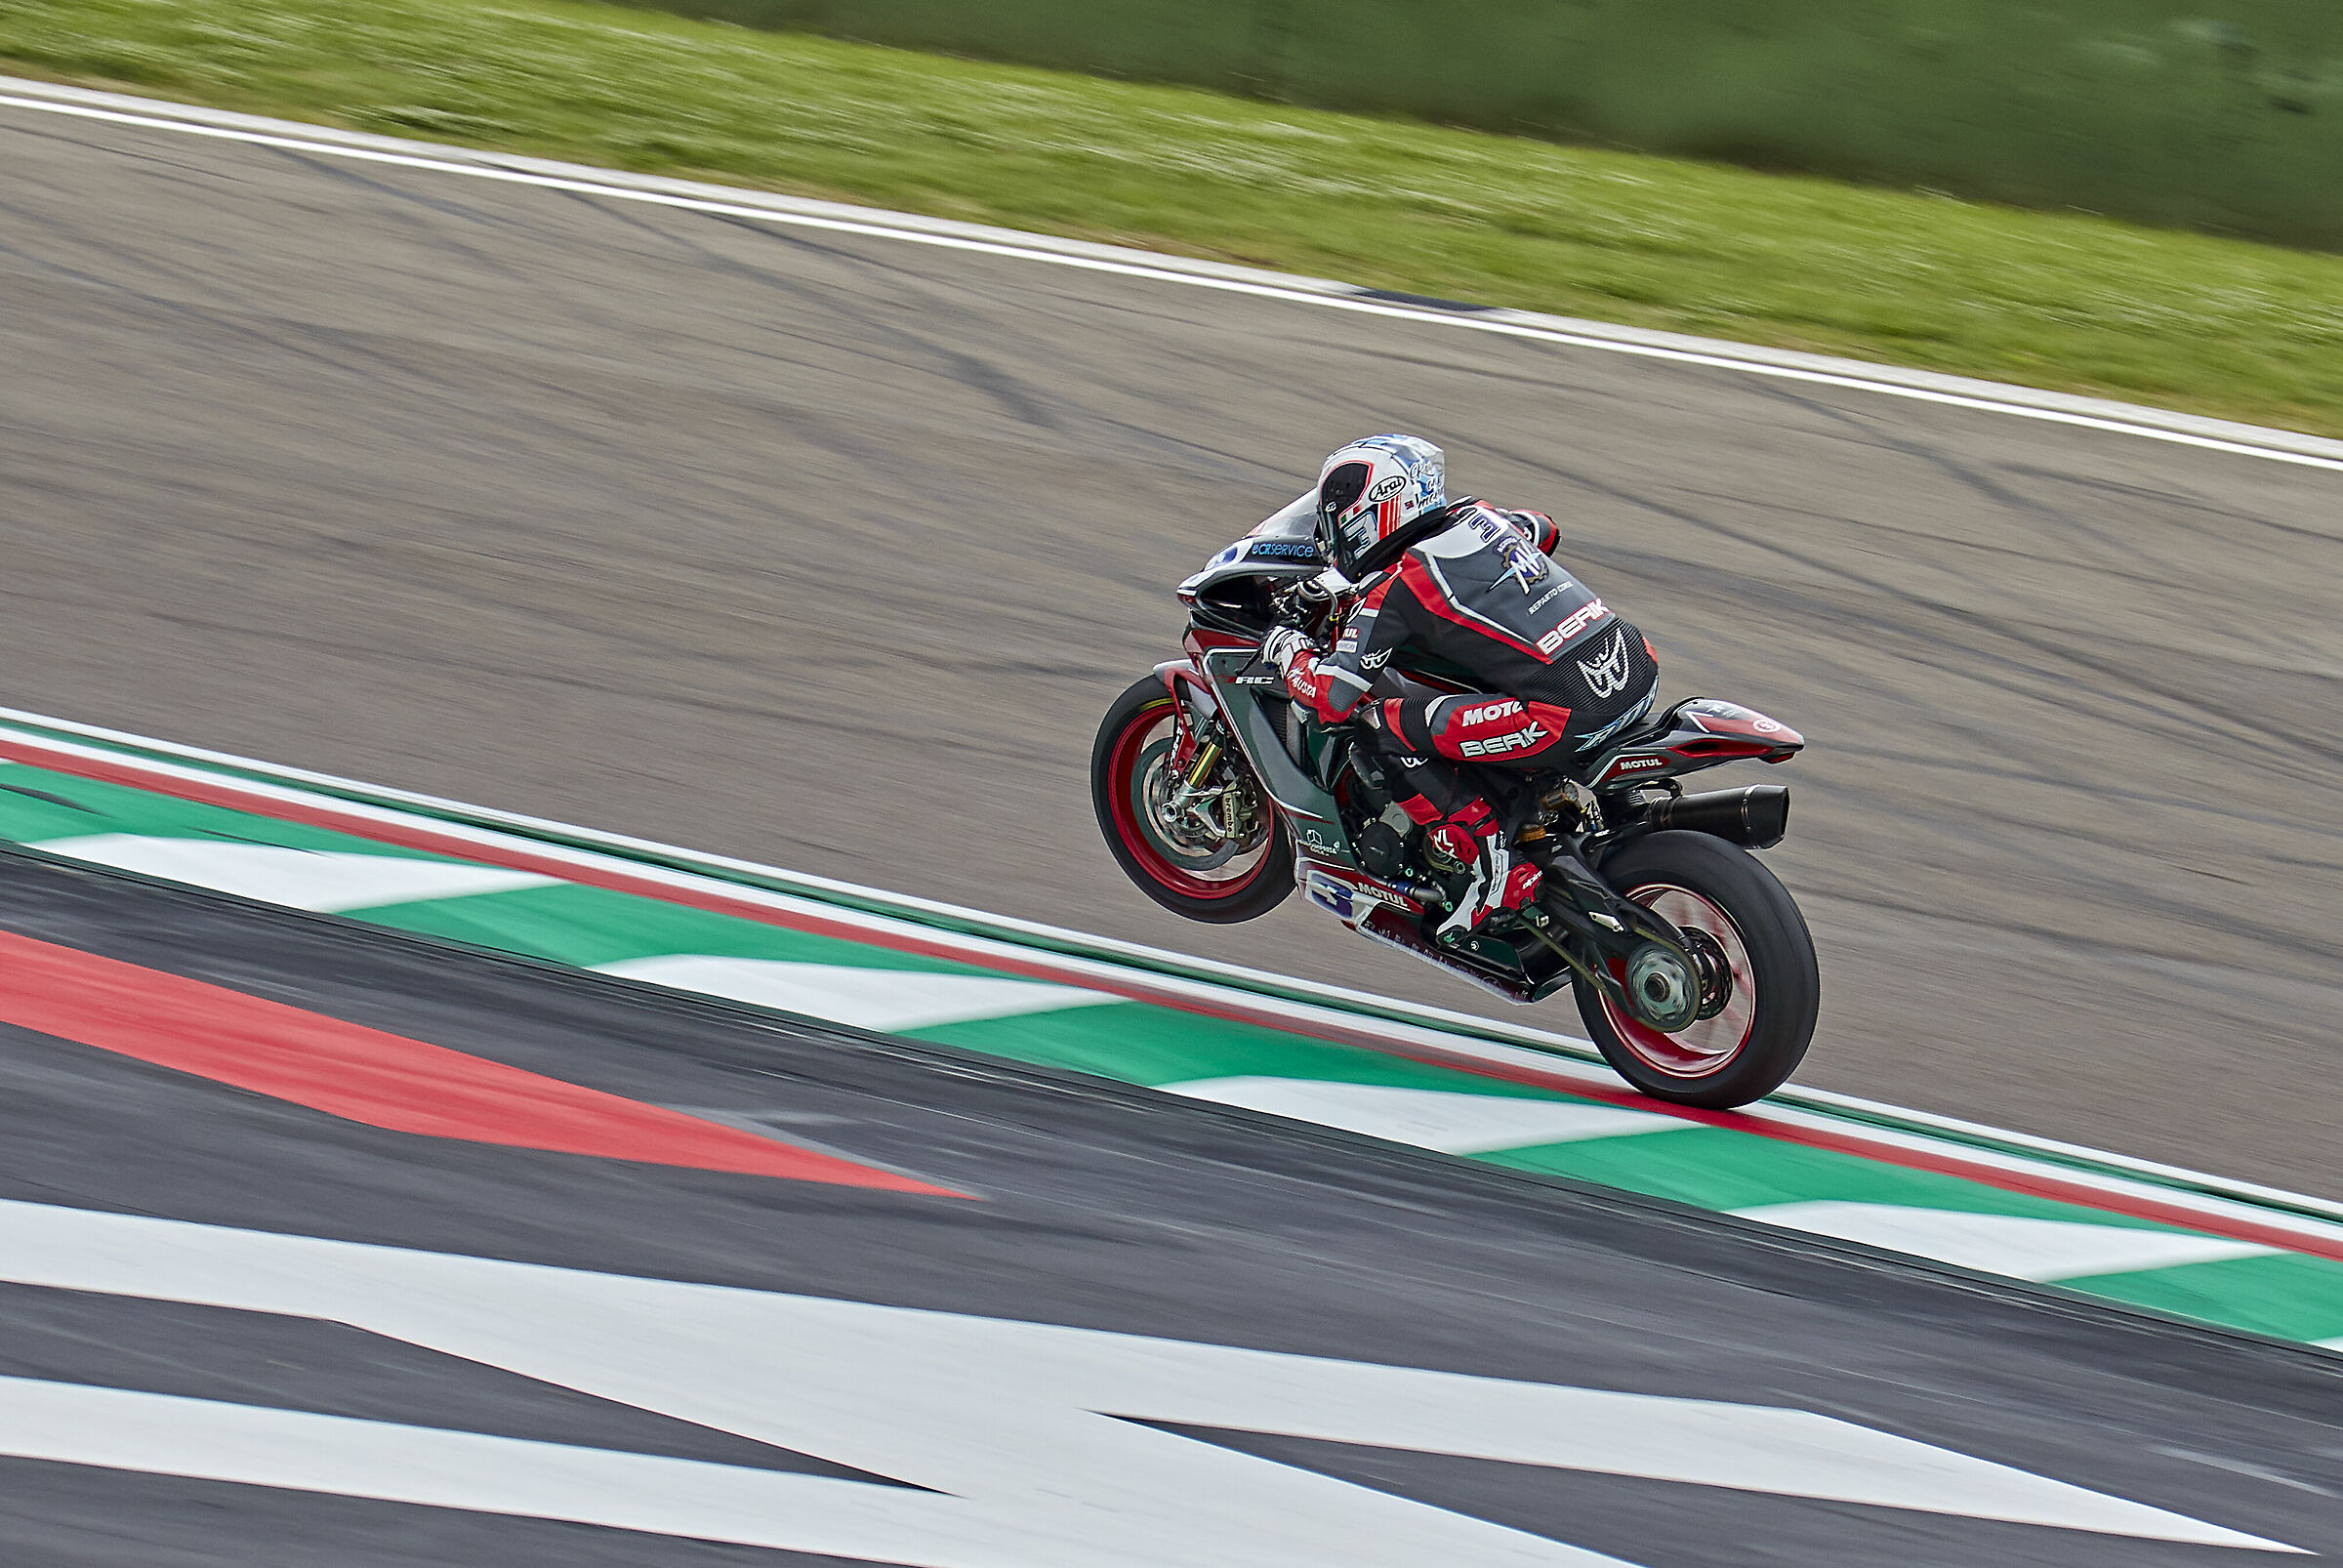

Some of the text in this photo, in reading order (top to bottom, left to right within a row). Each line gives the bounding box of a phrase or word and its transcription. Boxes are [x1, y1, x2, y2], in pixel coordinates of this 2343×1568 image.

[1375, 476, 1402, 499] Arai
[1461, 700, 1523, 727] MOTU
[1620, 758, 1664, 770] MOTUL
[1357, 882, 1408, 908] MOTUL
